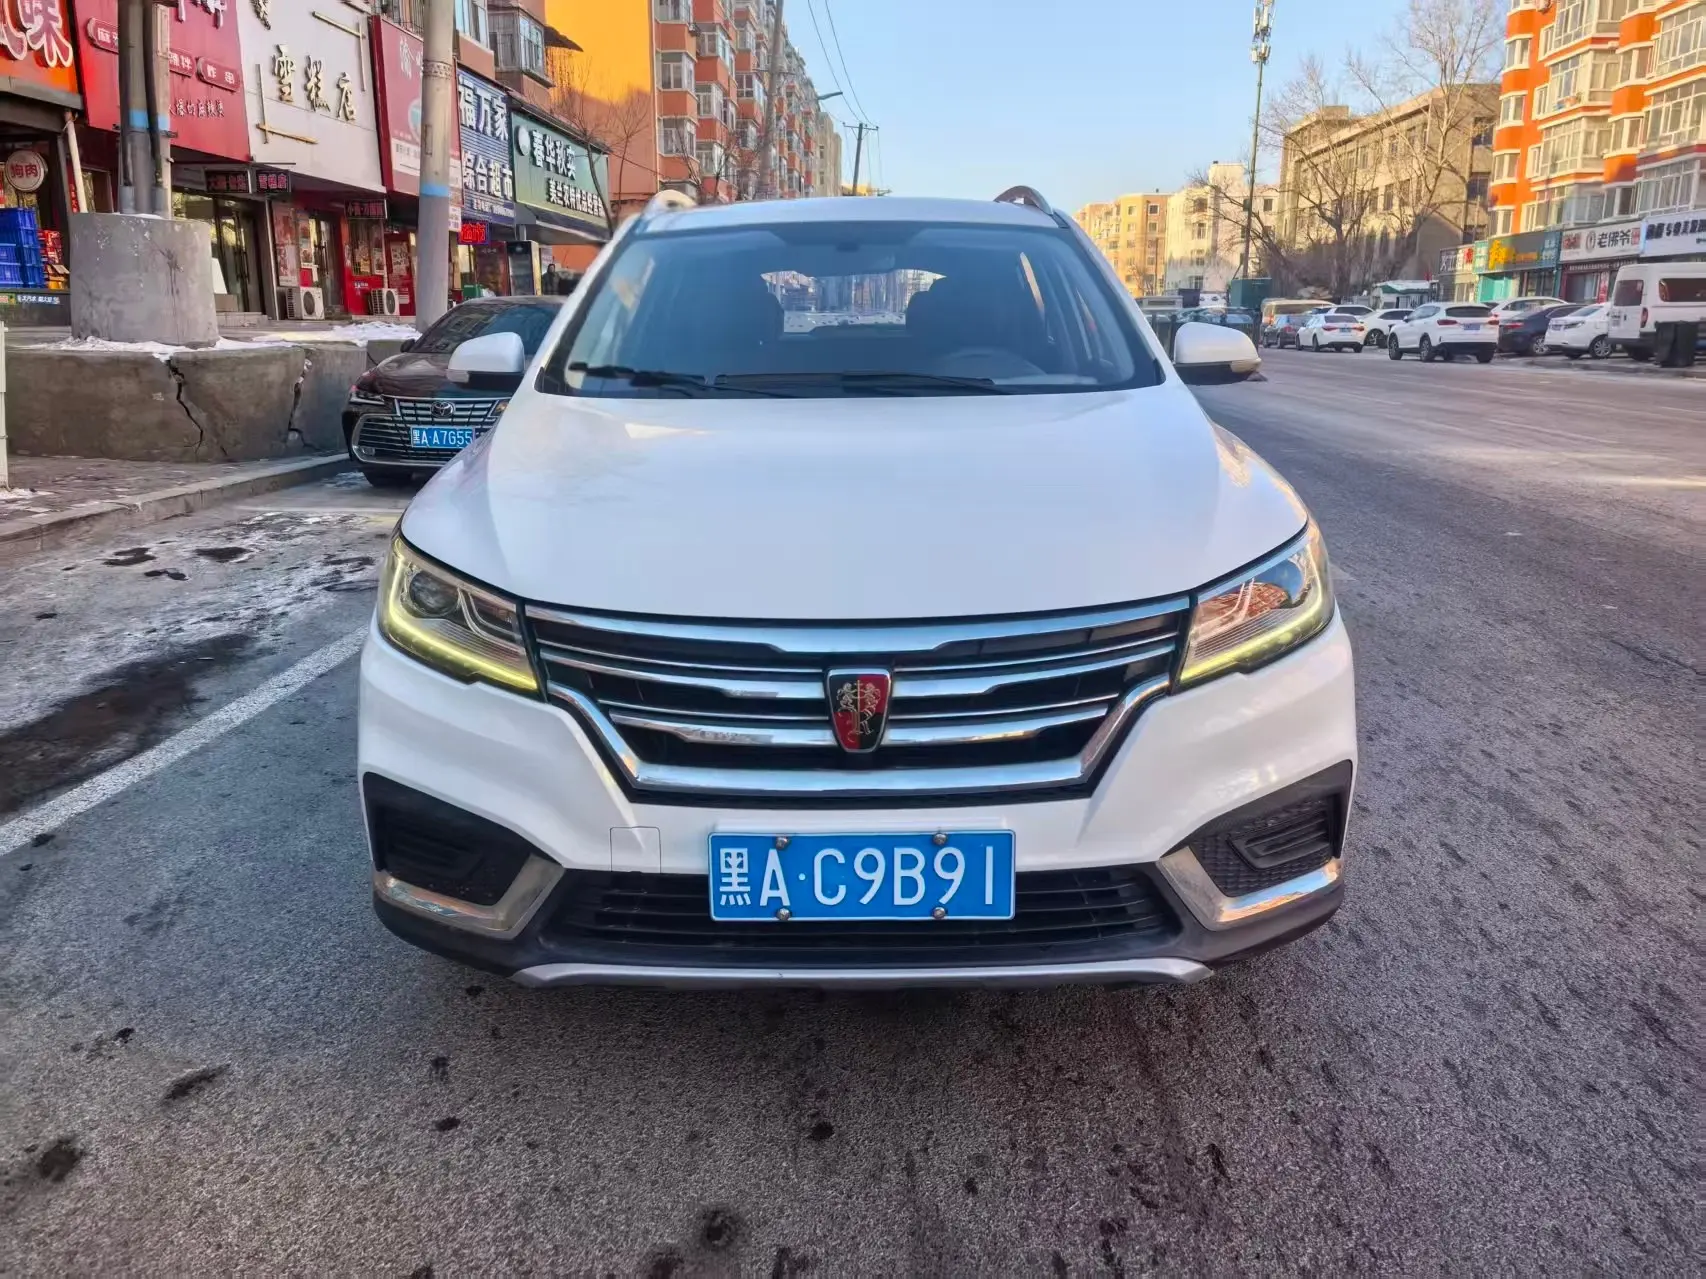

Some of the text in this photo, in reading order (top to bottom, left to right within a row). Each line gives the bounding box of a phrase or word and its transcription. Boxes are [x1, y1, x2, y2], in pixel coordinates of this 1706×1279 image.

[272, 44, 357, 122] 雪糕店
[458, 74, 508, 141] 福万家
[11, 163, 38, 178] 狗肉
[462, 150, 513, 200] 综合超市
[532, 129, 576, 181] 春华秋实
[1597, 228, 1632, 249] 老佛爷
[719, 845, 994, 907] 黑A·C9B91
